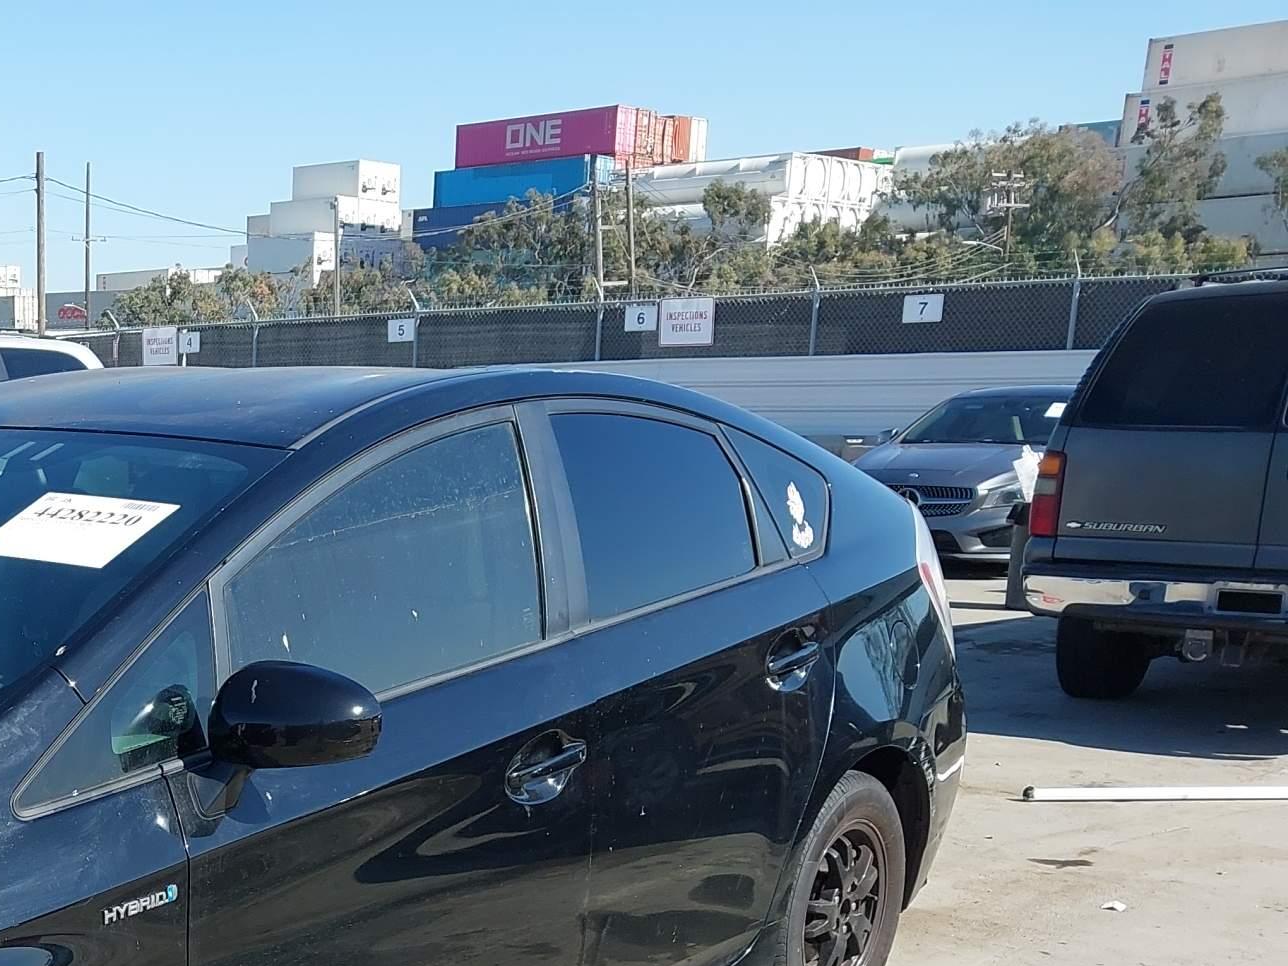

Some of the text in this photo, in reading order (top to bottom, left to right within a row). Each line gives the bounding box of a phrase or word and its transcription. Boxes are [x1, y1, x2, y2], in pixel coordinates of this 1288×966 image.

[506, 120, 562, 149] ONE
[918, 301, 929, 315] 7
[637, 312, 645, 325] 6
[666, 311, 708, 320] INSPECTIONS
[398, 324, 405, 337] 5
[672, 323, 701, 332] VEHICLES
[186, 337, 192, 348] 4
[34, 507, 143, 526] 44282220
[1083, 521, 1167, 534] SUBURBAN
[102, 890, 168, 925] HYBRID
